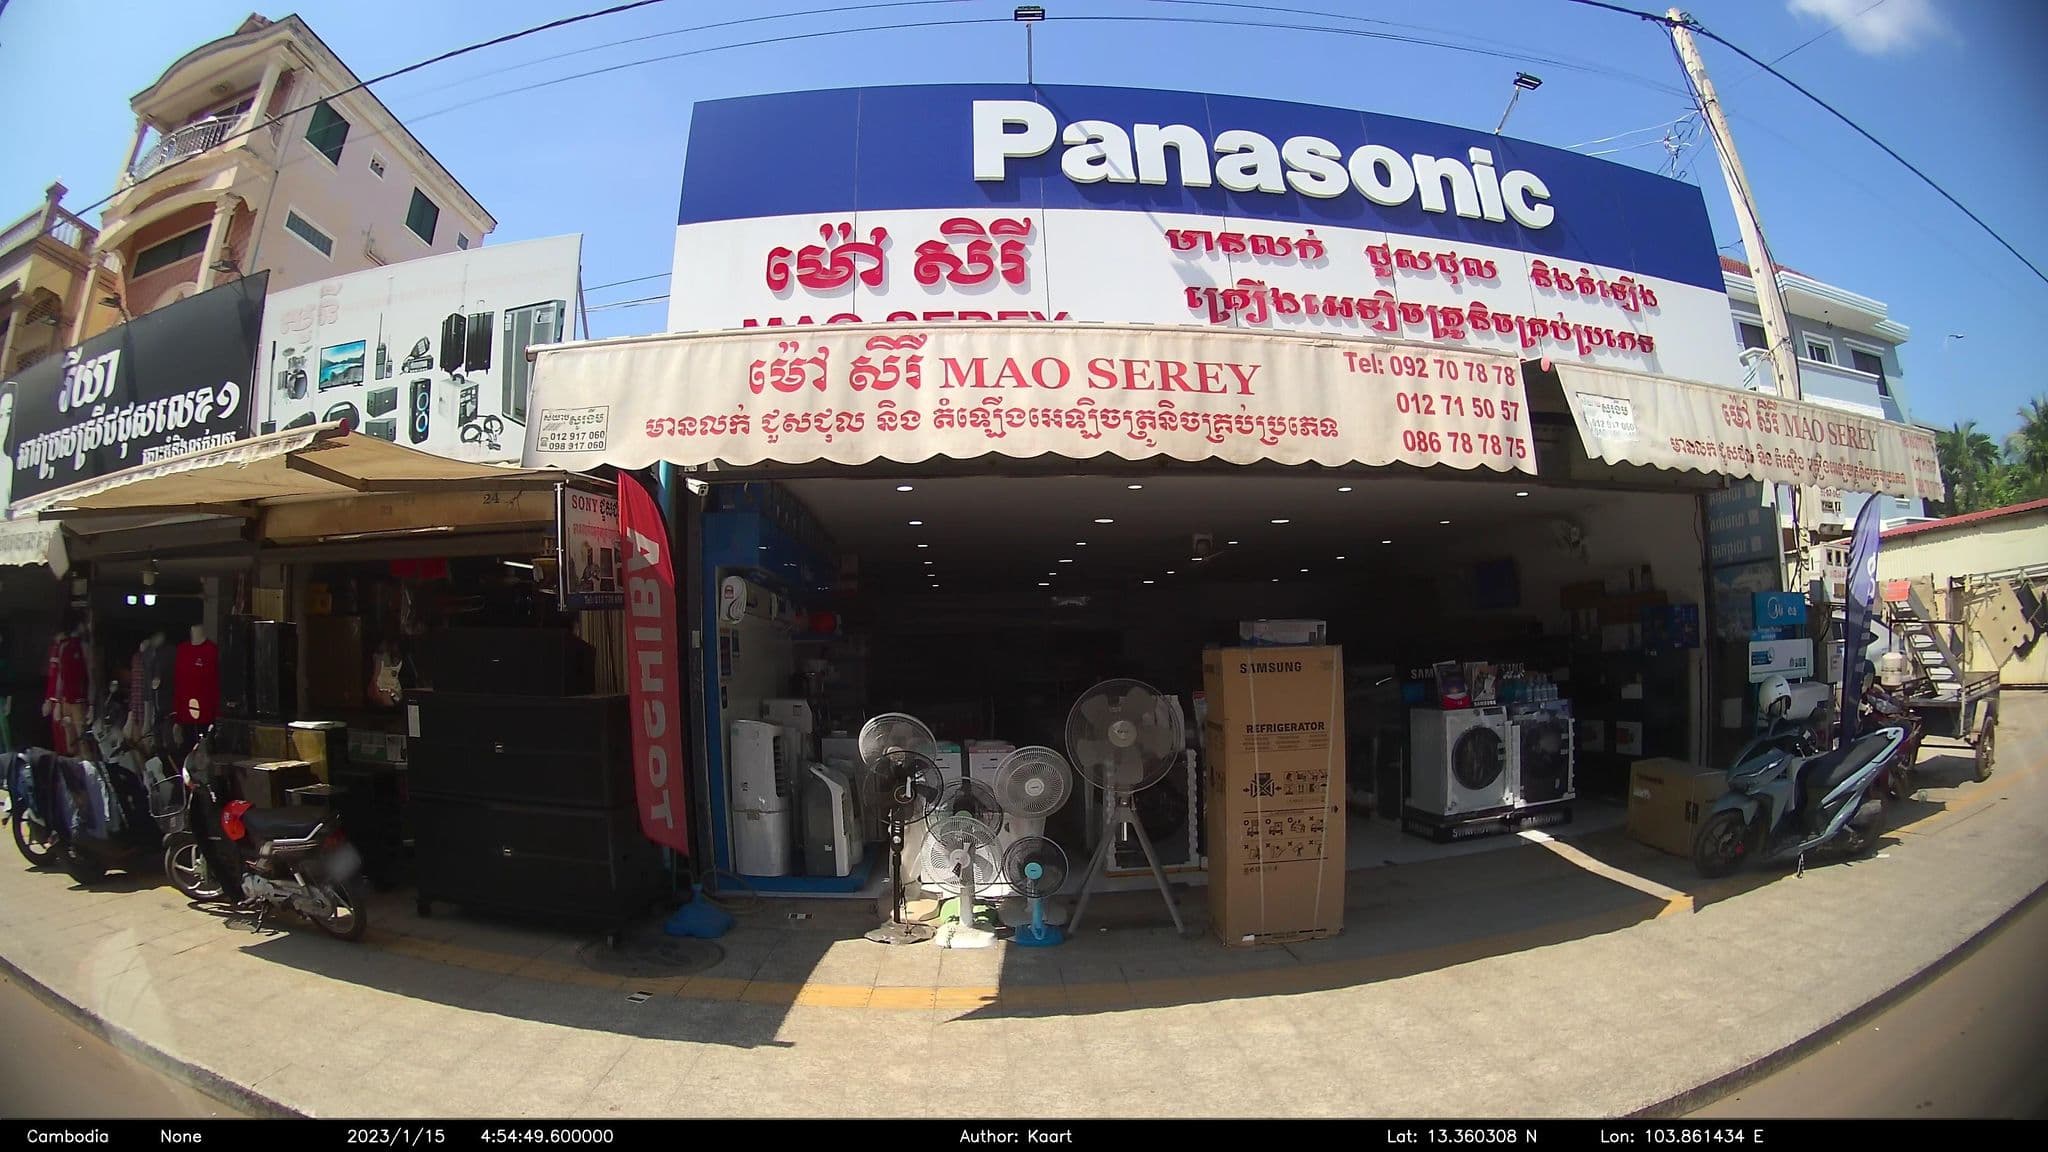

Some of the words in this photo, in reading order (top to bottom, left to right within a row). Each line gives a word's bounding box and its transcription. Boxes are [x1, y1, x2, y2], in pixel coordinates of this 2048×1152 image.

[971, 100, 1555, 229] Panasonic
[939, 356, 1072, 390] MAO
[1087, 357, 1262, 396] SEREY
[1343, 351, 1384, 374] Tel:
[1389, 356, 1429, 379] 092
[1434, 359, 1459, 380] 70
[1464, 361, 1488, 383] 78
[1492, 365, 1516, 387] 78
[877, 399, 921, 432] និង
[1396, 393, 1436, 415] 012
[1440, 395, 1465, 416] 71
[1472, 397, 1495, 419] 50
[1500, 400, 1519, 422] 57
[549, 442, 566, 450] 098
[568, 441, 585, 450] 917
[587, 440, 604, 449] 060
[550, 432, 567, 441] 012
[569, 432, 586, 441] 917
[588, 430, 605, 440] 060
[1403, 430, 1441, 453] 086
[1447, 432, 1473, 454] 78
[1478, 433, 1502, 455] 78
[1506, 436, 1526, 459] 75
[1781, 412, 1825, 443] MAO
[1828, 421, 1877, 451] SEREY
[572, 494, 598, 513] SONY
[1240, 661, 1303, 674] SAMSUNG
[1246, 721, 1325, 734] REFRIGERATOR
